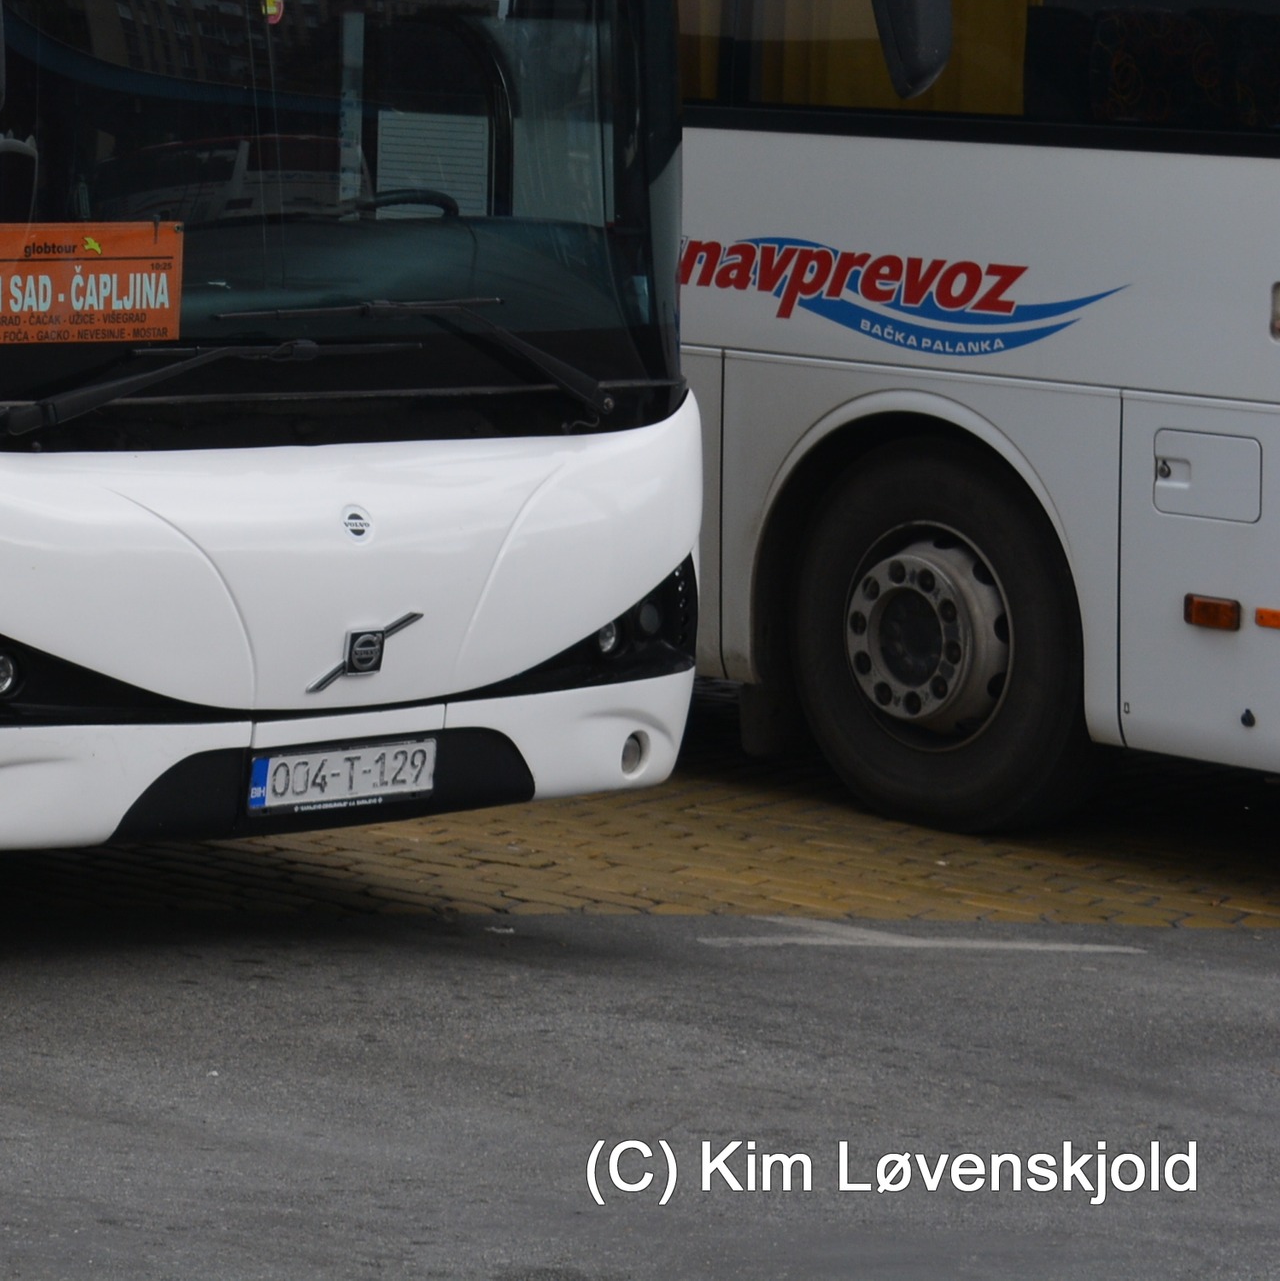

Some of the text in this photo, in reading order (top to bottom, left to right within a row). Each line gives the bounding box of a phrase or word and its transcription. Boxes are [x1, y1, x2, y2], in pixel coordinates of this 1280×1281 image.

[24, 242, 77, 258] globtour
[680, 236, 1029, 318] navprevoz
[9, 274, 52, 313] SAD
[71, 265, 169, 311] ČAPLJINA
[29, 313, 62, 326] ČAČAK
[69, 312, 95, 325] UŽICE
[102, 311, 147, 324] VIŠEGRAD
[3, 328, 29, 342] FOČA
[36, 330, 70, 341] GACKO
[77, 328, 126, 340] NEVESINJE
[132, 327, 168, 338] MOSTAR
[860, 319, 1005, 354] BAČKA PALANKA
[250, 786, 266, 798] BIH
